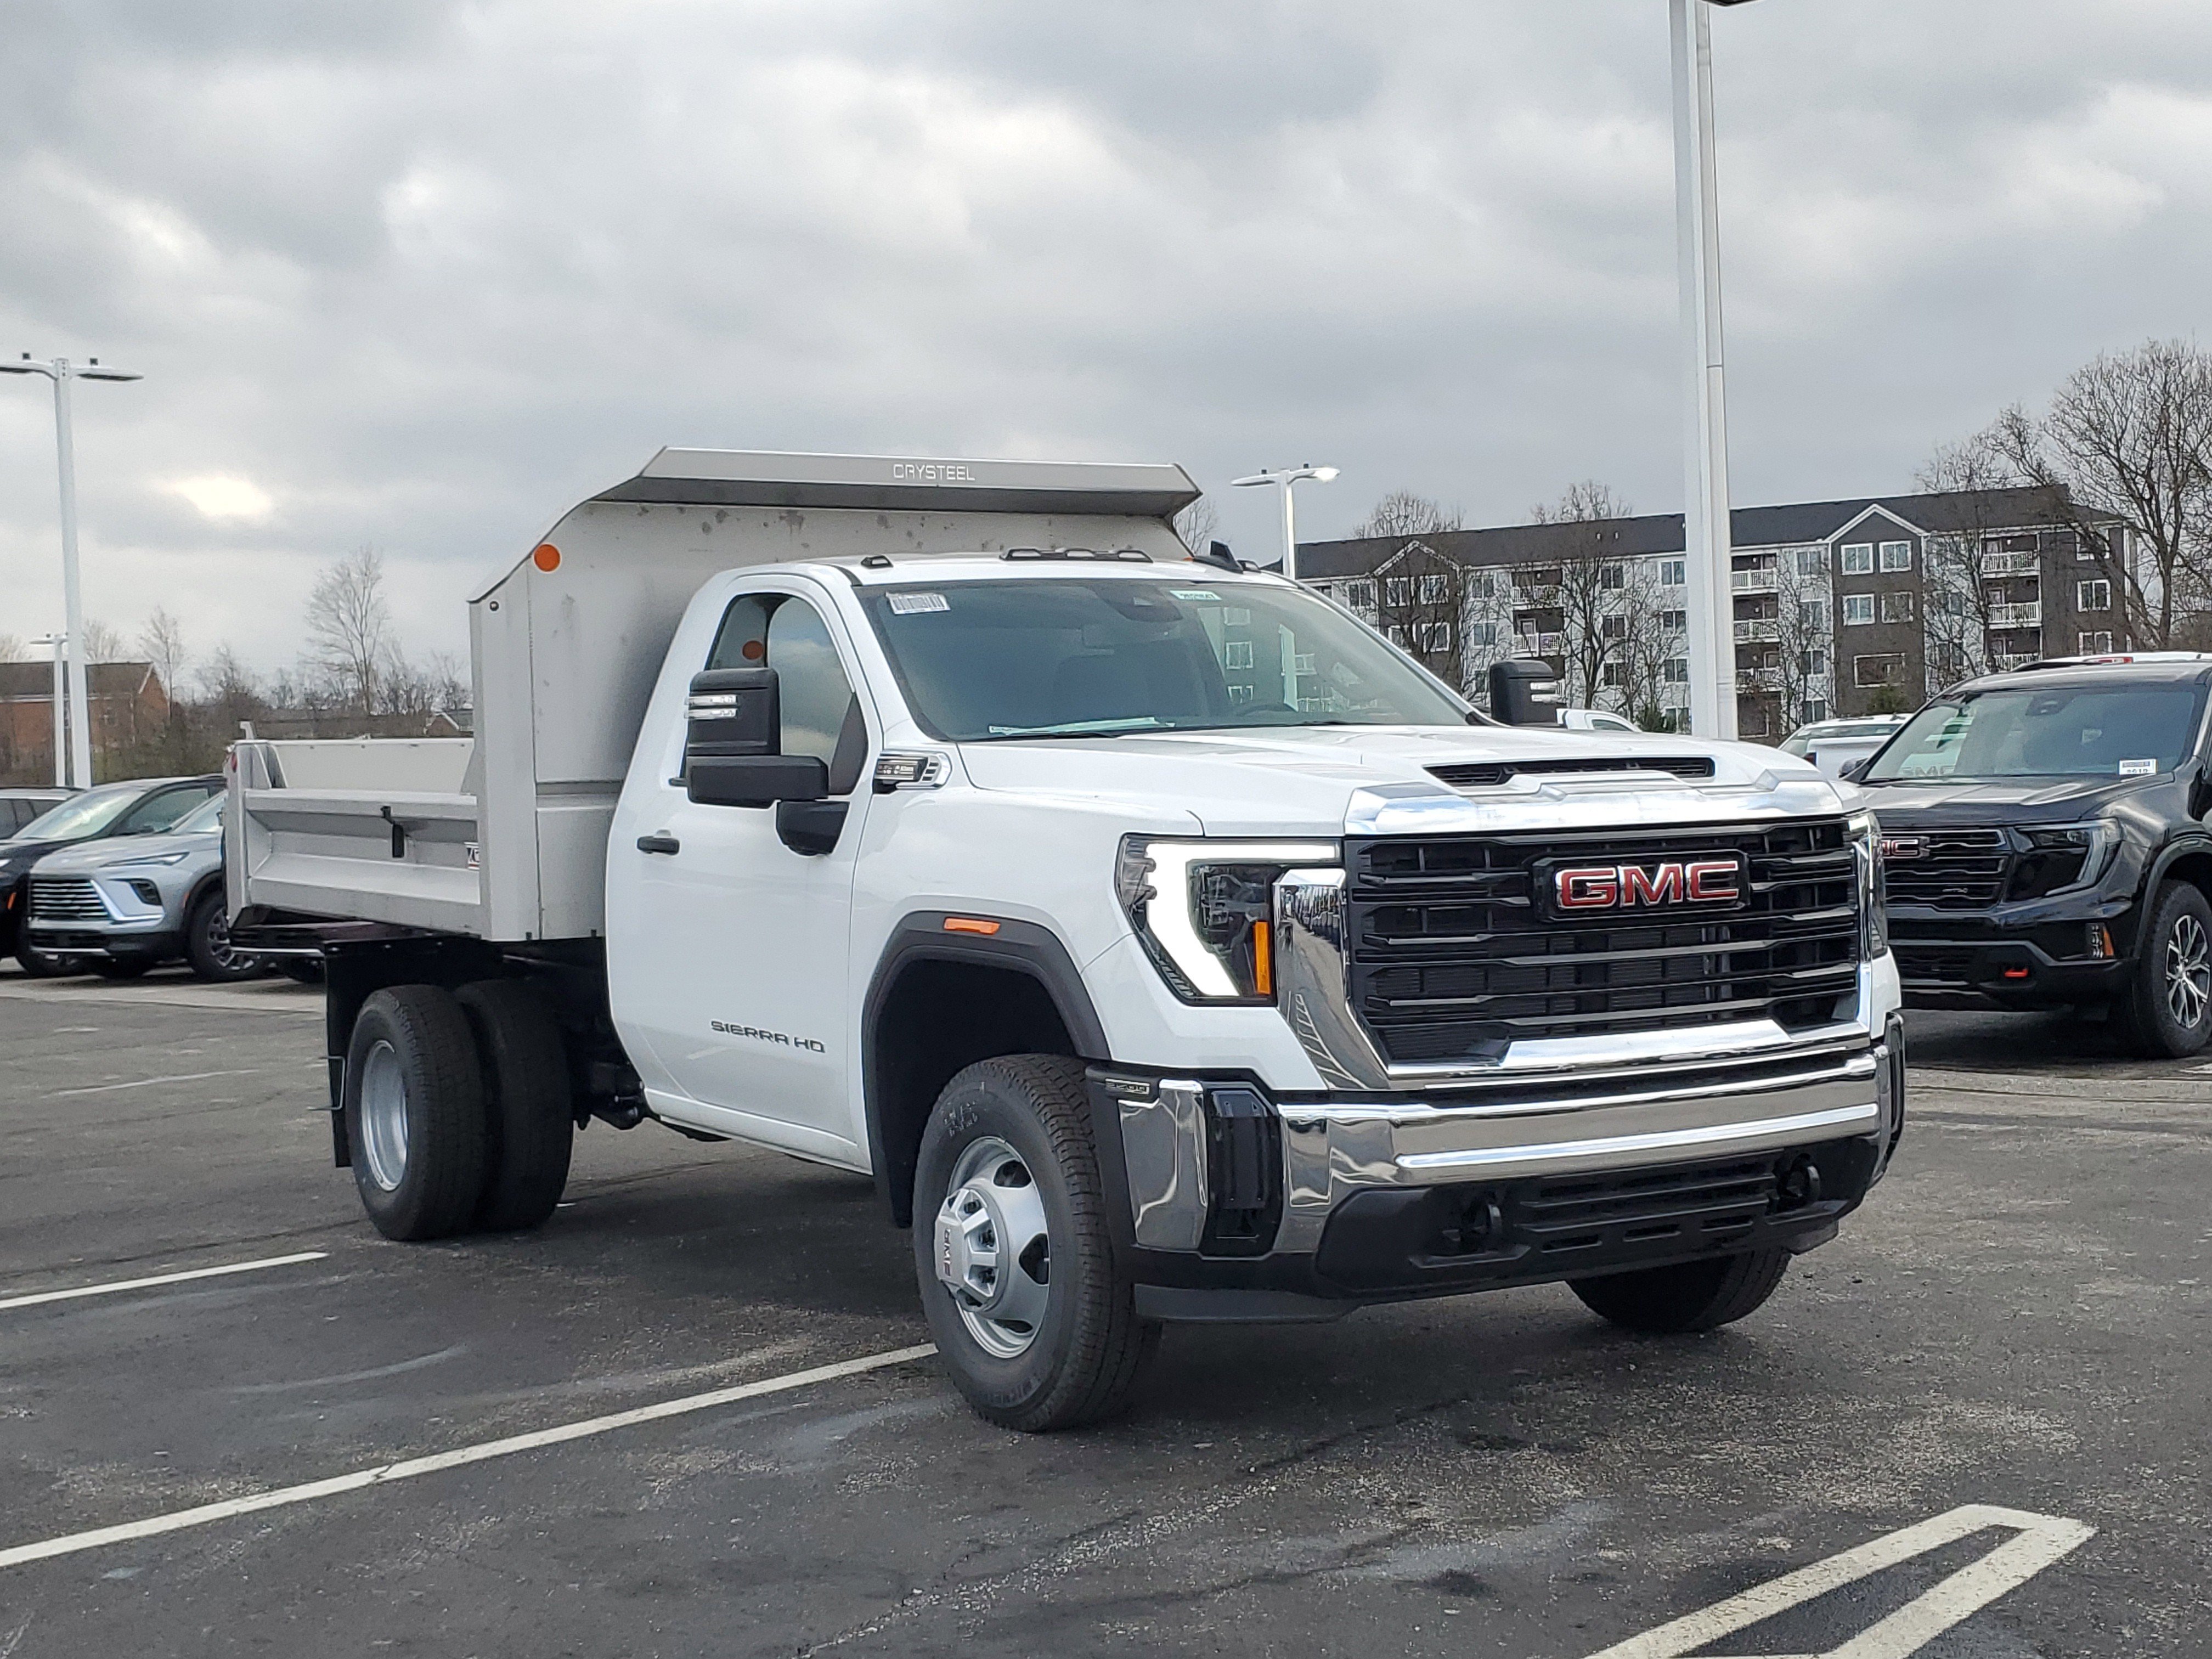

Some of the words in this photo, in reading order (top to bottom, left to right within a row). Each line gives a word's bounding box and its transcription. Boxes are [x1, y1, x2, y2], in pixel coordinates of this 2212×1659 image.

[893, 464, 975, 481] CRYSTEEL
[1555, 861, 1739, 910] GMC
[711, 1020, 789, 1045] SIERRA
[794, 1036, 825, 1053] HD
